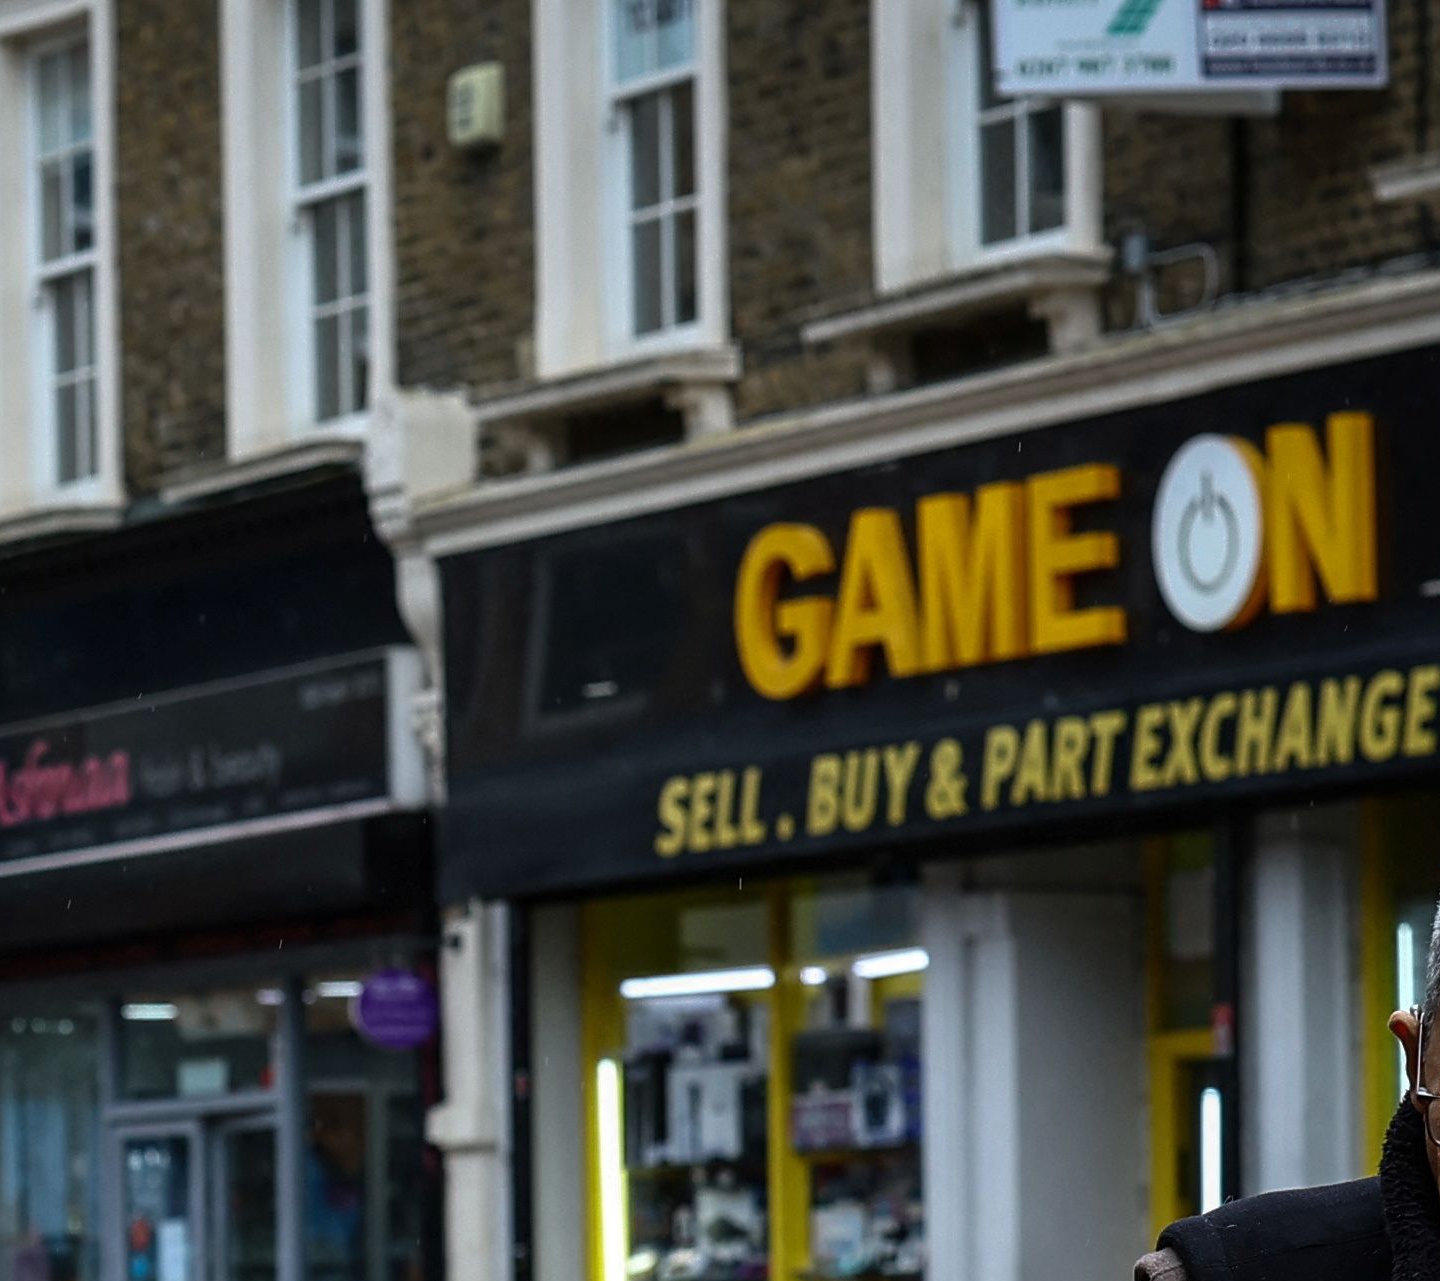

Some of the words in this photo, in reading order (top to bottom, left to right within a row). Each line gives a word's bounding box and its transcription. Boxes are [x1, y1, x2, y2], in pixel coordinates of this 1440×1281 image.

[735, 463, 1127, 701] GAME
[654, 766, 766, 858] SELL
[807, 740, 924, 837] BUY
[925, 737, 968, 821] &
[980, 709, 1128, 811] PART
